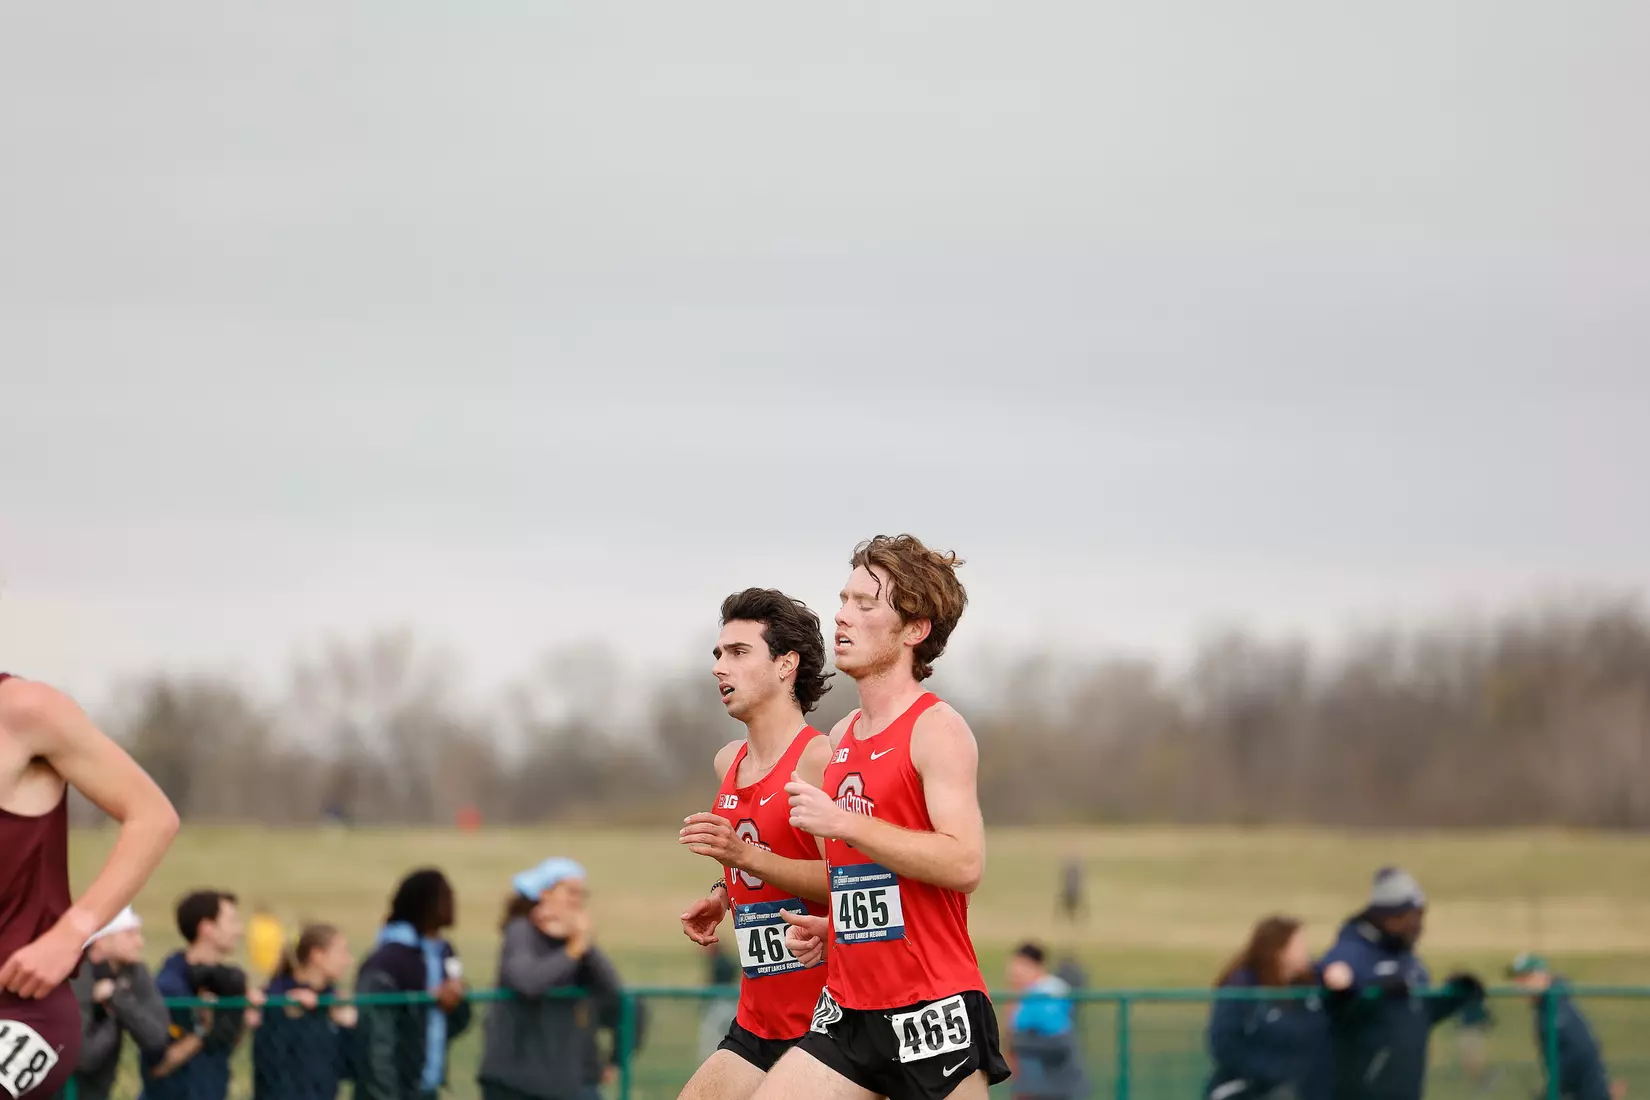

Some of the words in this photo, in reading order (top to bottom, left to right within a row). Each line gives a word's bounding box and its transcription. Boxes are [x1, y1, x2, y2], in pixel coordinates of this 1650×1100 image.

[839, 889, 889, 930] 465
[902, 1001, 968, 1055] 465
[0, 1026, 48, 1092] 18
